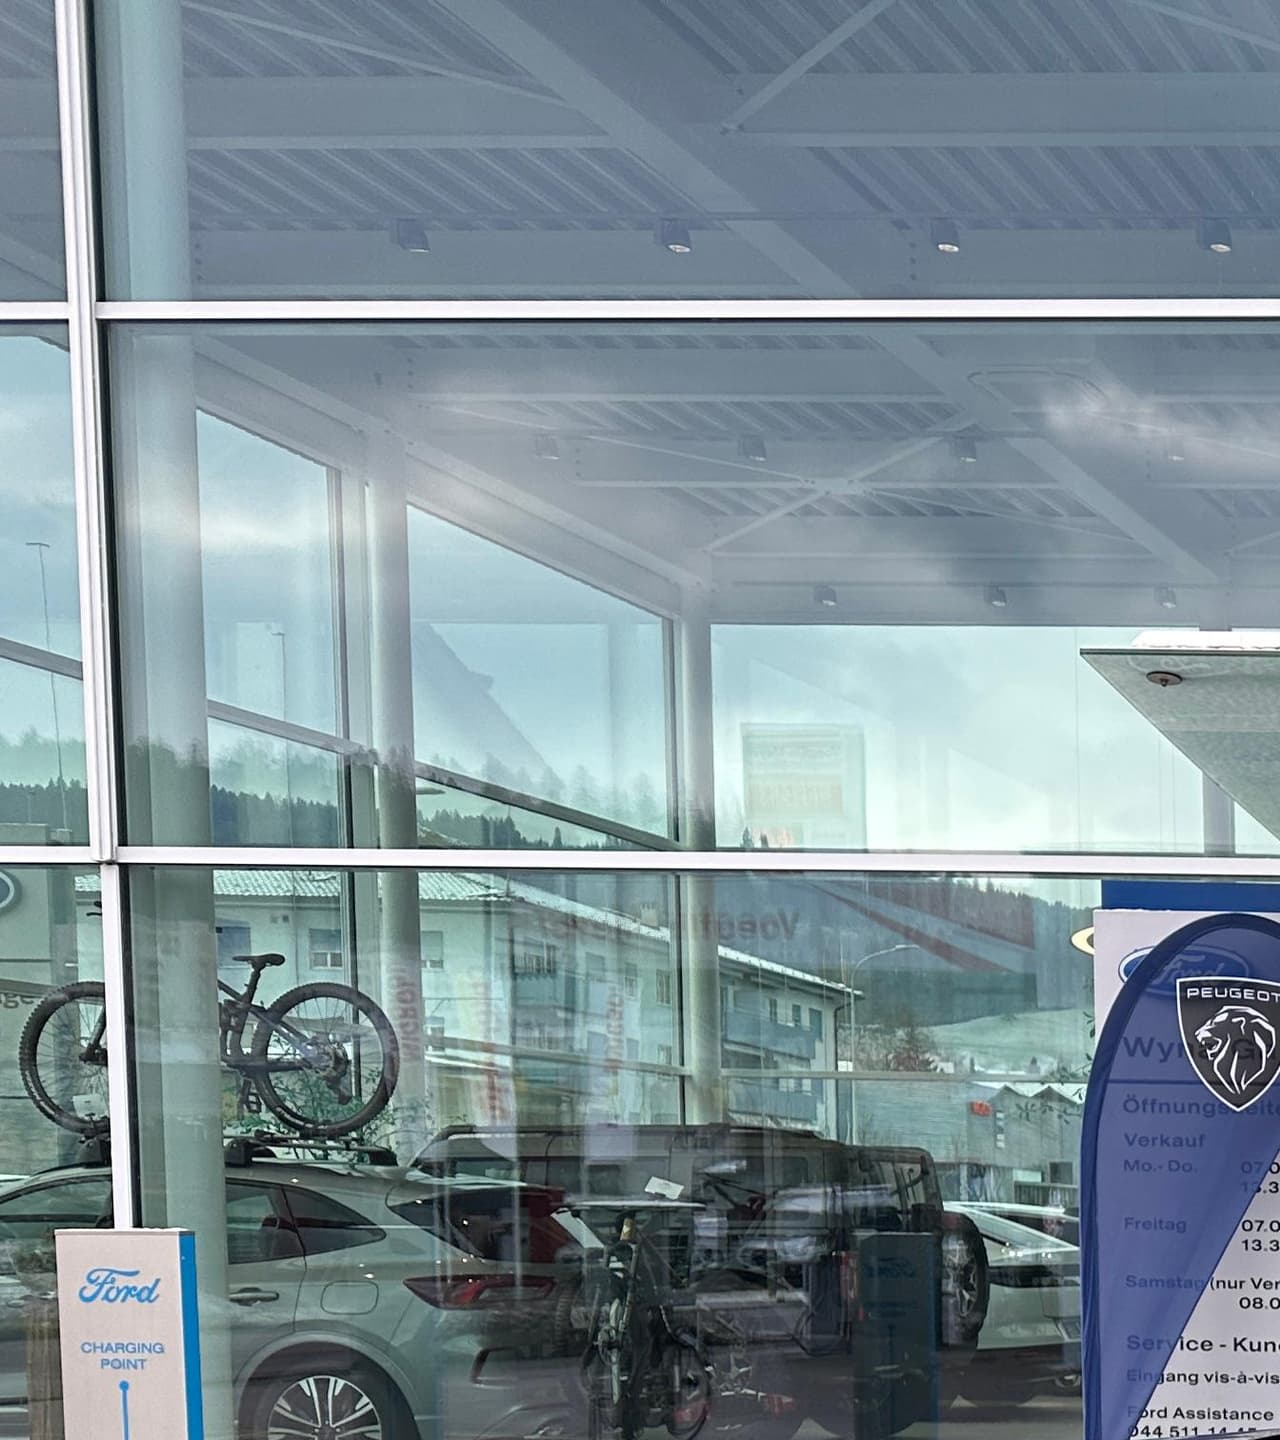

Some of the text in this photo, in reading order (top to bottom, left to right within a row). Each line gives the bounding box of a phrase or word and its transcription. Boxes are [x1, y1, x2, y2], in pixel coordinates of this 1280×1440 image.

[1124, 1133, 1206, 1148] Verkauf
[1124, 1217, 1187, 1233] Freitag
[79, 1268, 160, 1303] Ford
[1209, 1276, 1246, 1292] (nur
[80, 1341, 165, 1354] CHARGING
[1127, 1335, 1213, 1352] Service
[100, 1358, 147, 1370] POINT
[1126, 1369, 1280, 1386] Eingang vis-à-vis
[1127, 1406, 1168, 1420] Ford
[1173, 1407, 1274, 1421] Assistance
[1127, 1425, 1163, 1438] 044
[1169, 1426, 1198, 1438] 511
